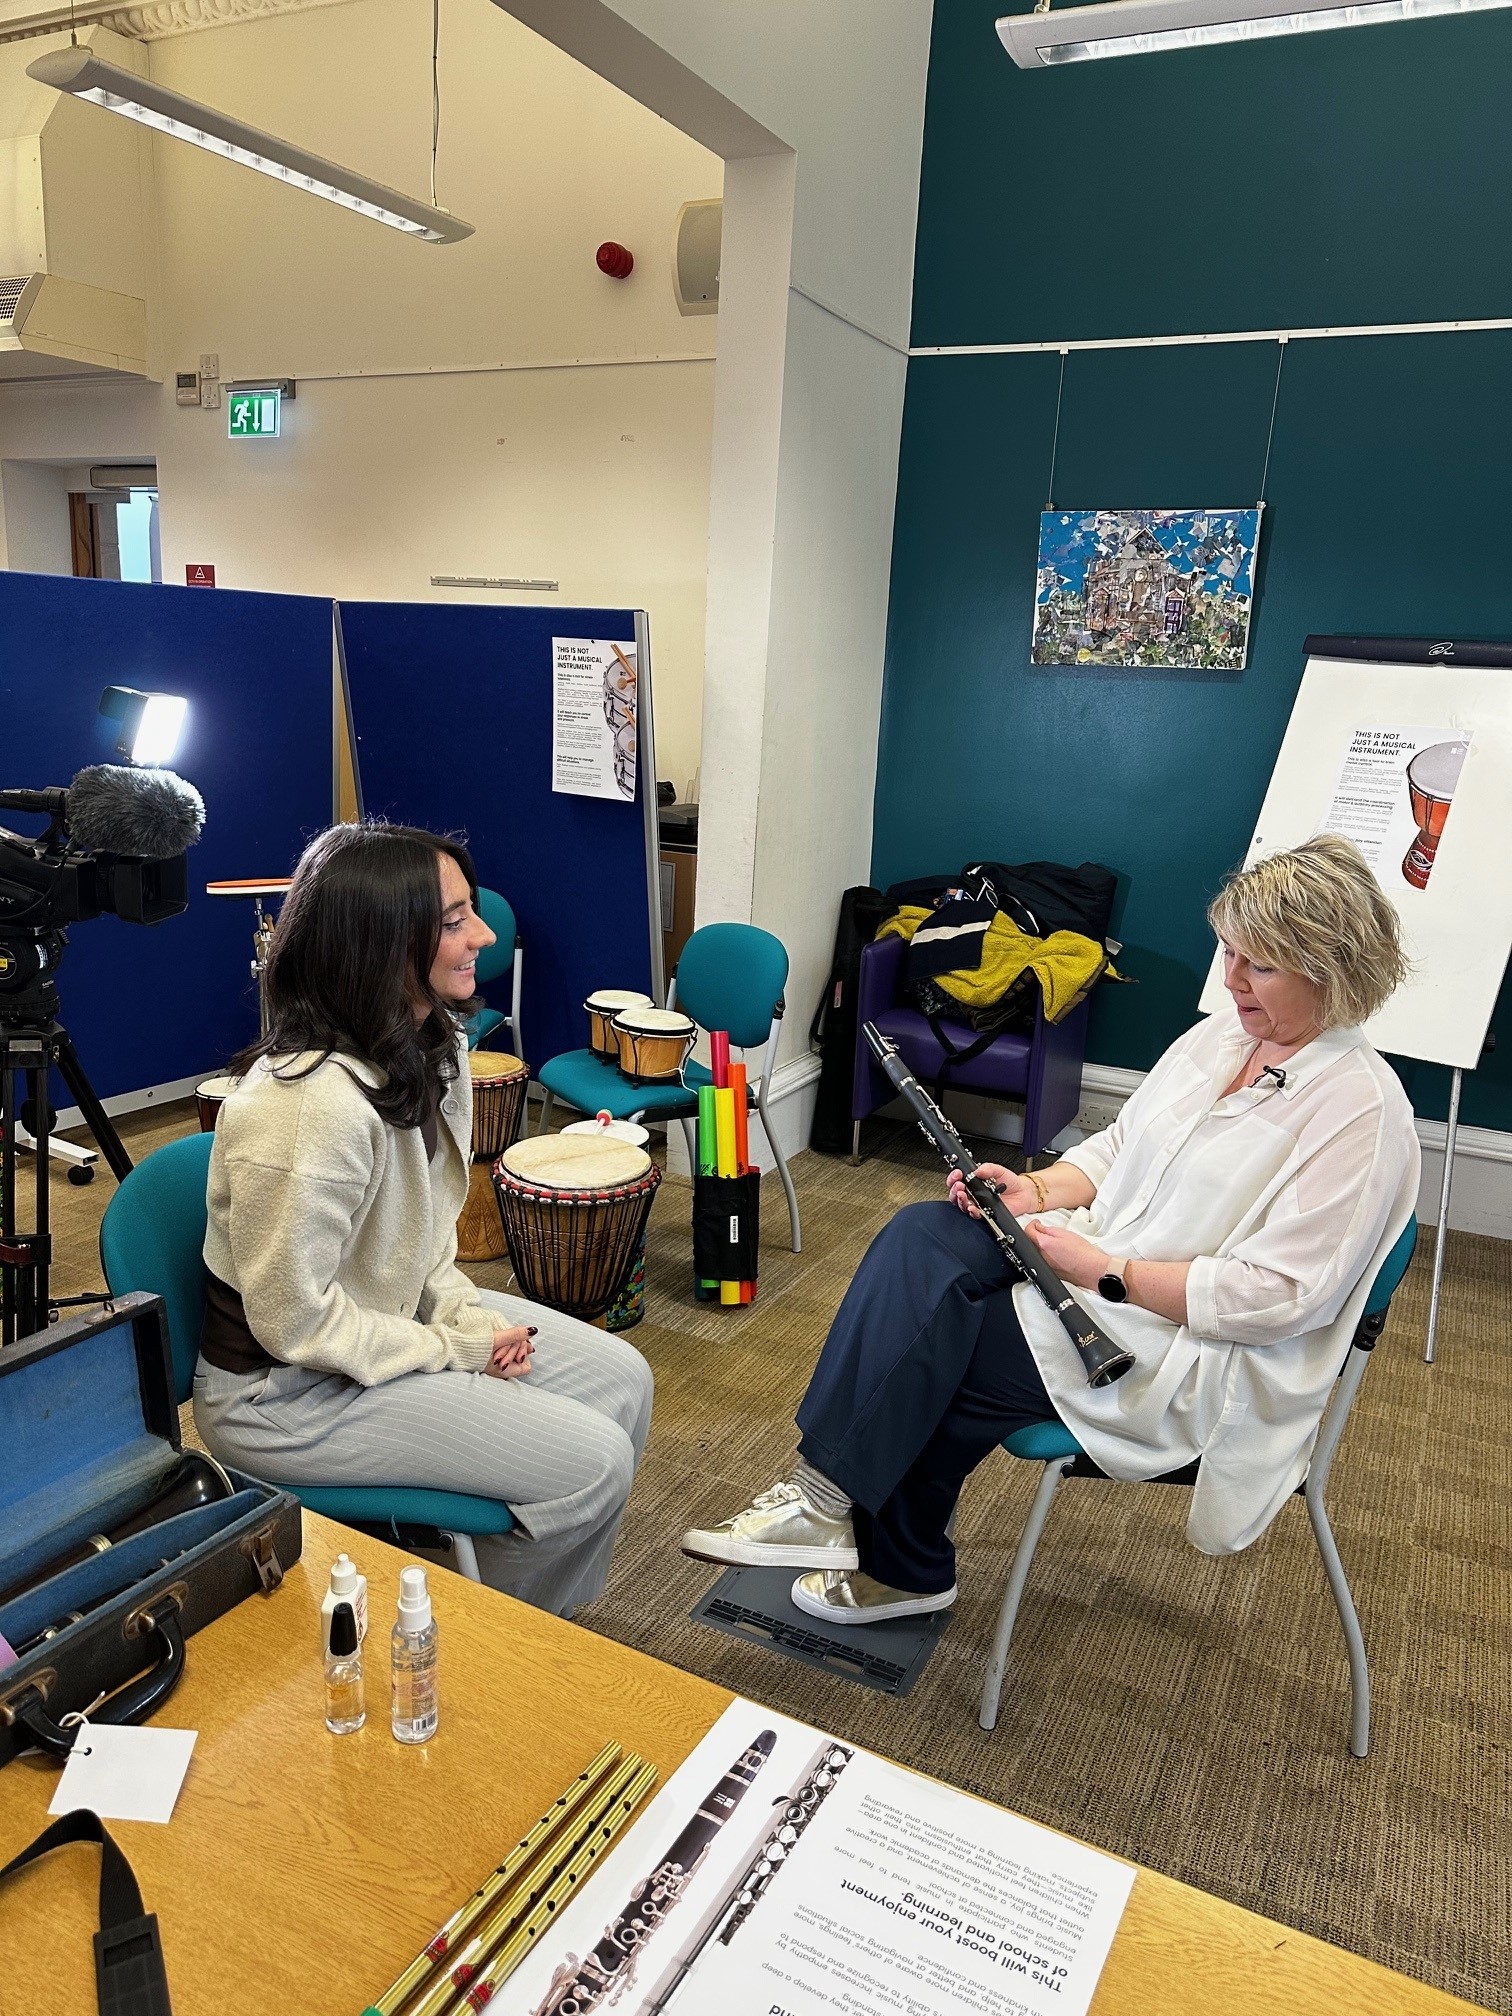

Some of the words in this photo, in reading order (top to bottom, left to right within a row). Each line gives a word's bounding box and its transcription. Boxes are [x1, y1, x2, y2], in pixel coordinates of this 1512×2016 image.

[557, 662, 594, 671] INSTRUMENT.
[1349, 746, 1401, 756] INSTRUMENT.
[1381, 741, 1416, 749] MUSICAL
[860, 1802, 881, 1813] other
[864, 1794, 902, 1815] rewarding
[883, 1812, 902, 1824] their
[883, 1819, 898, 1829] one
[904, 1813, 920, 1823] and
[868, 1828, 887, 1841] work.
[900, 1827, 908, 1835] in
[905, 1821, 921, 1832] into
[922, 1821, 954, 1838] positive
[845, 1827, 877, 1843] creative
[909, 1831, 946, 1851] confident
[924, 1830, 971, 1854] enthusiasm
[955, 1836, 977, 1849] more
[834, 1845, 855, 1858] more
[886, 1845, 903, 1856] and
[889, 1838, 930, 1860] academic
[947, 1849, 965, 1860] and
[858, 1857, 874, 1868] feel
[974, 1853, 991, 1865] that
[987, 1850, 1021, 1870] learning
[878, 1866, 887, 1874] to
[906, 1853, 960, 1882] achievement,
[941, 1862, 980, 1884] demands
[965, 1857, 1009, 1880] motivated
[995, 1862, 1017, 1876] carry
[1023, 1866, 1055, 1885] making
[890, 1872, 910, 1885] tend
[982, 1881, 996, 1892] the
[1010, 1878, 1026, 1889] feel
[1051, 1873, 1097, 1897] experience.
[915, 1884, 941, 1899] music
[928, 1882, 956, 1898] school.
[973, 1886, 998, 1900] sense
[1028, 1886, 1062, 1905] children
[1058, 1883, 1095, 1904] subjects,
[840, 1879, 916, 1920] enjoyment
[945, 1898, 953, 1907] in
[958, 1895, 967, 1903] at
[998, 1889, 1037, 1912] balances
[1077, 1900, 1092, 1912] like
[797, 1904, 837, 1927] situations
[901, 1892, 962, 1930] learning.
[968, 1901, 1014, 1925] connected
[1009, 1901, 1025, 1914] joy,
[1039, 1907, 1057, 1920] that
[1064, 1903, 1089, 1919] When
[793, 1911, 815, 1925] more
[958, 1904, 1006, 1929] participate
[1026, 1910, 1053, 1927] brings
[1059, 1917, 1084, 1932] outlet
[818, 1922, 851, 1945] feelings,
[839, 1925, 865, 1941] social
[918, 1918, 953, 1938] your
[964, 1924, 995, 1943] and
[1010, 1929, 1028, 1941] who
[1015, 1923, 1034, 1934] and
[1056, 1924, 1081, 1940] Music
[774, 1939, 787, 1950] by
[780, 1932, 789, 1941] to
[1035, 1932, 1076, 1954] engaged
[790, 1938, 825, 1959] respond
[867, 1938, 913, 1965] navigating
[955, 1934, 998, 1962] boost
[998, 1940, 1049, 1968] school
[1034, 1940, 1073, 1962] Students
[789, 1946, 828, 1970] empathy
[826, 1957, 845, 1969] and
[1000, 1956, 1026, 1974] will
[761, 1962, 783, 1977] deep
[895, 1962, 923, 1979] aware
[915, 1963, 926, 1971] at
[917, 1954, 966, 1981] confidence.
[1050, 1965, 1068, 1979] of
[831, 1968, 872, 1994] increases
[846, 1967, 889, 1991] recognize
[925, 1977, 949, 1992] more
[928, 1970, 955, 1987] better
[967, 1979, 986, 1991] and
[1031, 1970, 1061, 1993] This
[793, 1979, 827, 2000] develop
[890, 1989, 900, 1998] to
[957, 1984, 976, 1996] and
[828, 1997, 849, 2012] they
[875, 1991, 903, 2009] music
[902, 1994, 930, 2012] ability
[951, 1990, 988, 2011] children
[980, 1993, 1001, 2010] help,
[988, 1989, 1028, 2013] kindness
[1004, 2006, 1014, 2016] to
